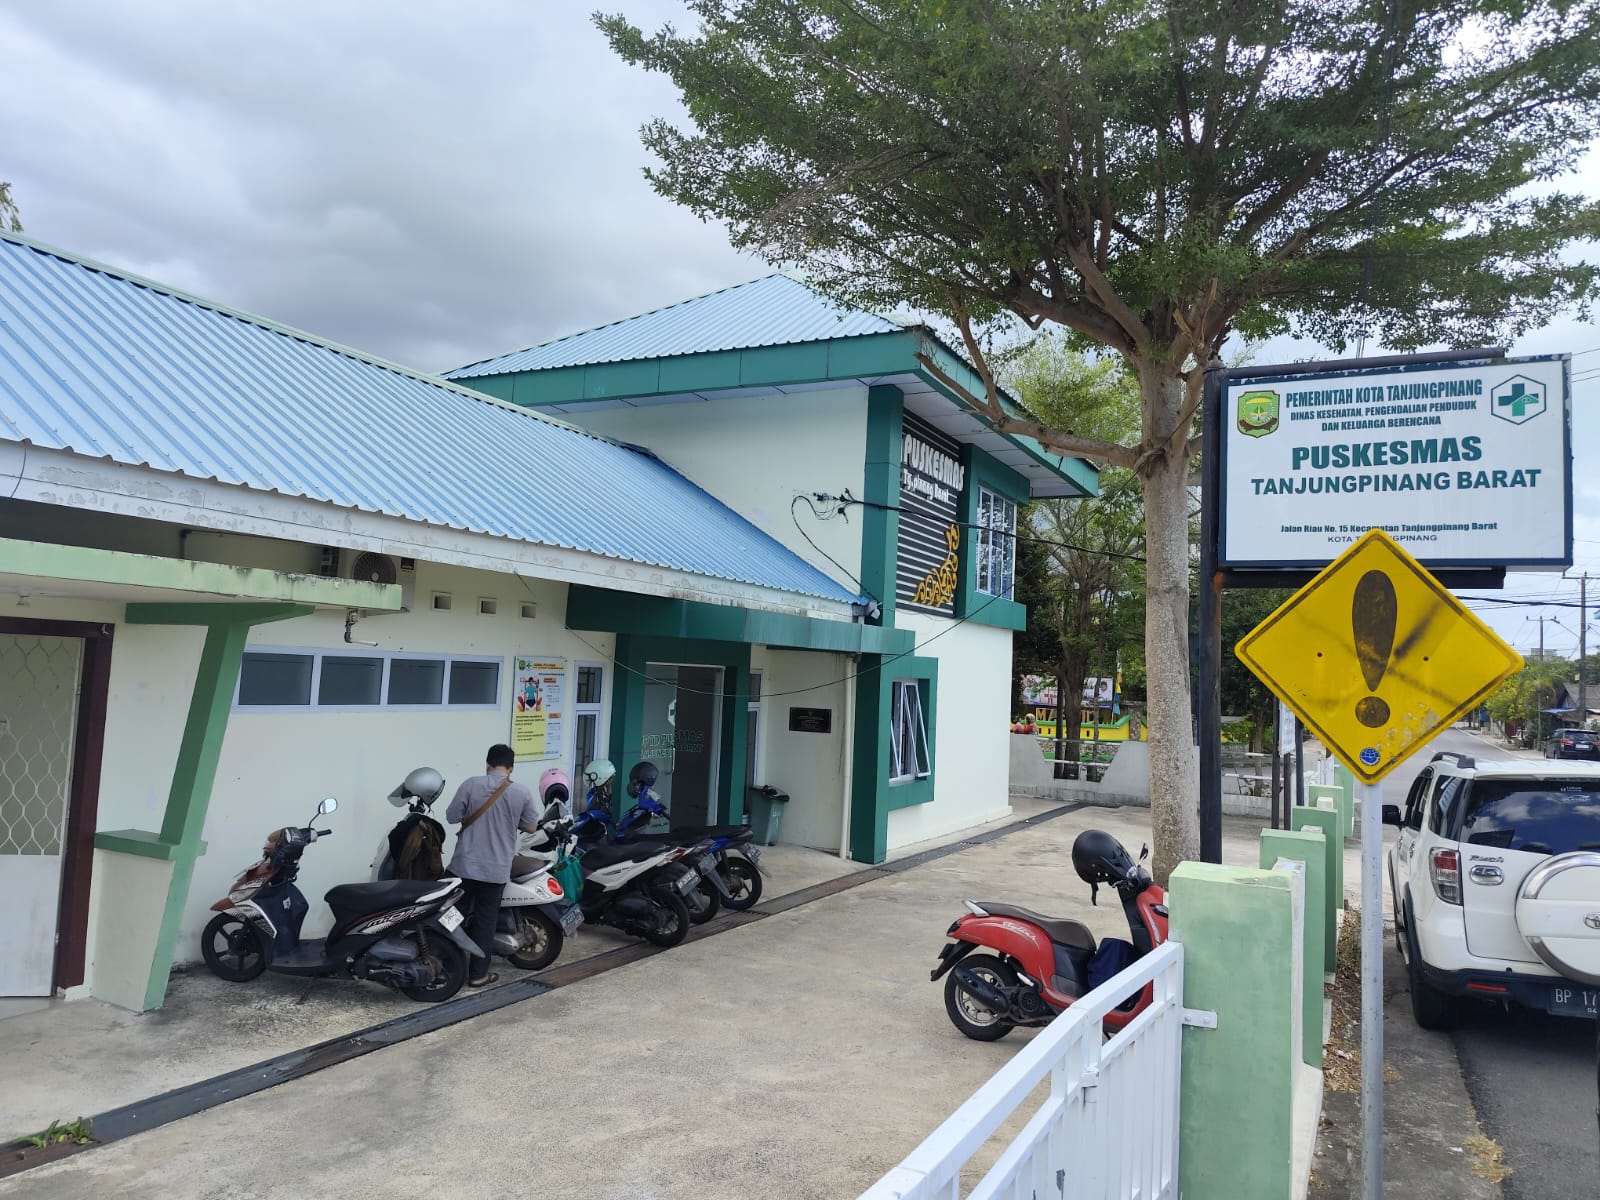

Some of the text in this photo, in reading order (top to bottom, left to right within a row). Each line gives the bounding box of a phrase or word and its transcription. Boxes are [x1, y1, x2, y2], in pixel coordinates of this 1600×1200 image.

[1285, 379, 1482, 408] PEMERINTAH KOTA TANJUNGPINANG
[1290, 410, 1315, 421] DINAS
[1365, 403, 1427, 416] PENGENDALIAN
[1429, 400, 1477, 411] PENDUDUK
[1321, 416, 1441, 432] DAN KELUARGA BERENCANA
[904, 434, 964, 491] PUSKESMAS
[1292, 435, 1482, 470] PUSKESMAS
[1251, 468, 1541, 495] TANJUNGPINANG BARAT
[1281, 525, 1302, 533] Jalan
[1304, 525, 1323, 533] Riau
[1401, 523, 1470, 532] Tanjungpinang
[1471, 522, 1498, 530] Barat
[1555, 989, 1600, 1006] BP 17
